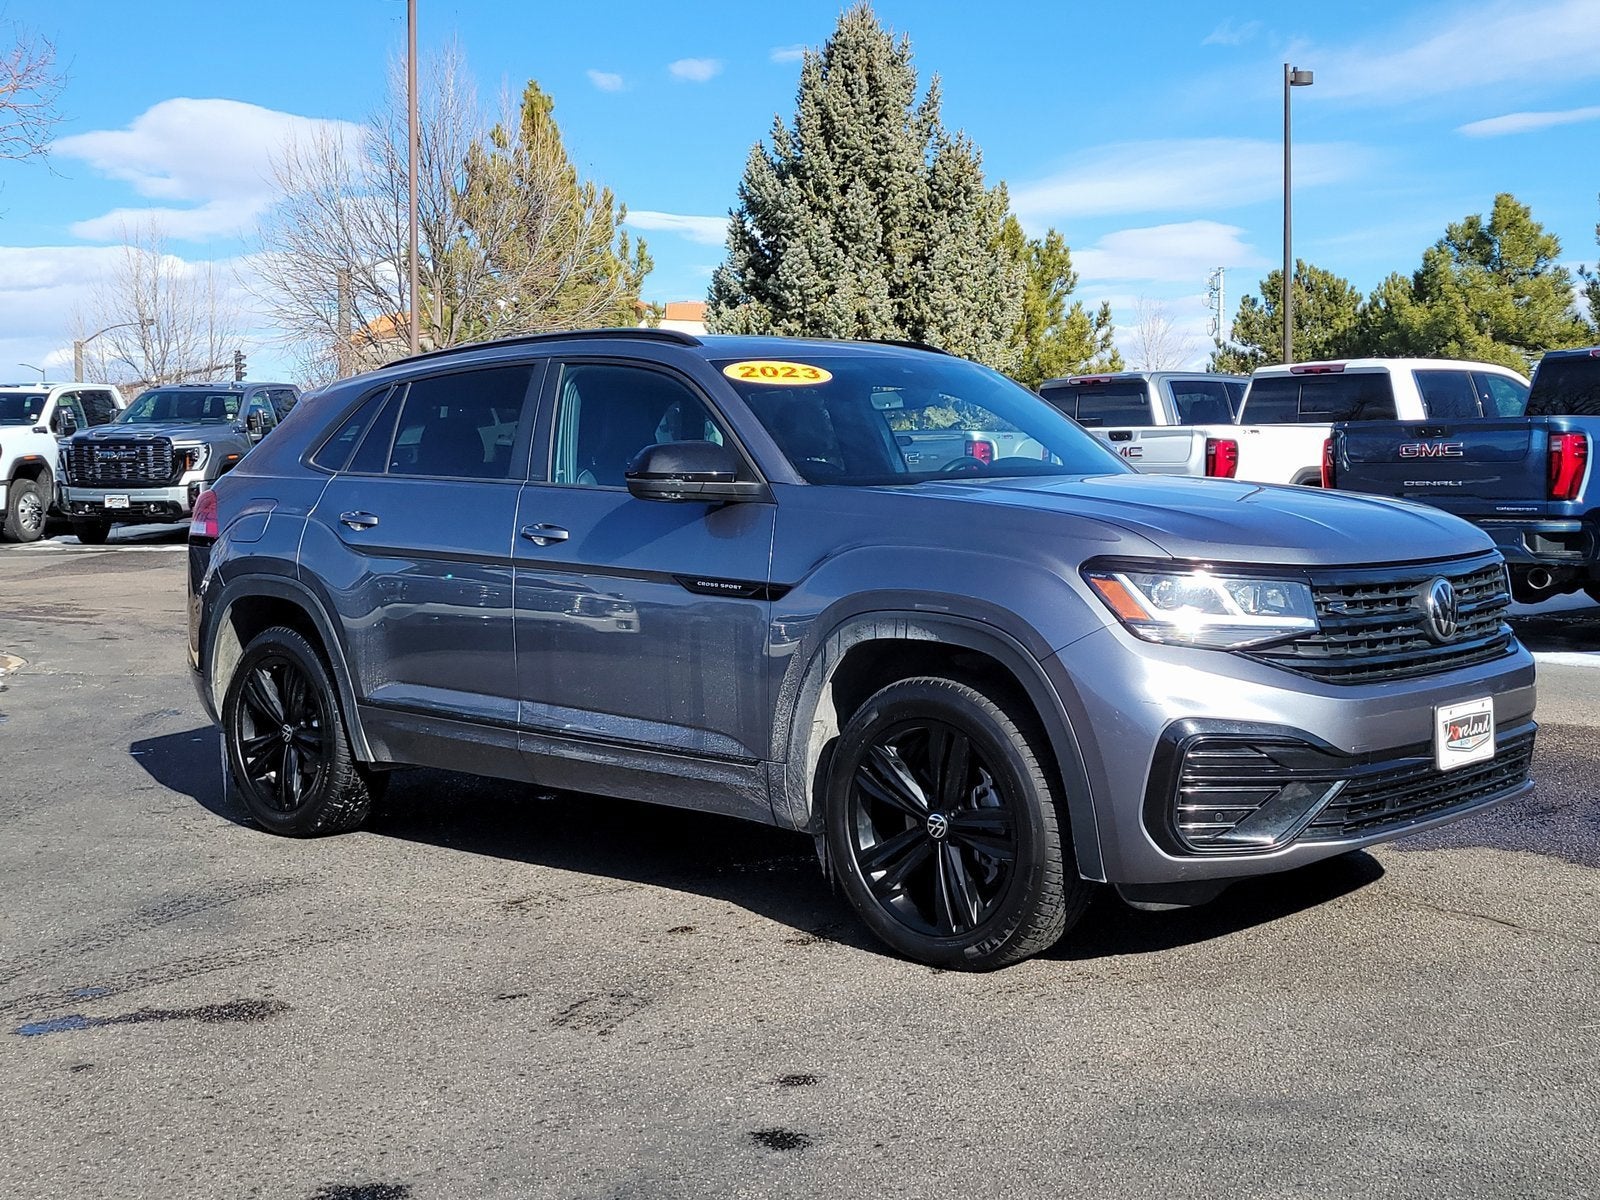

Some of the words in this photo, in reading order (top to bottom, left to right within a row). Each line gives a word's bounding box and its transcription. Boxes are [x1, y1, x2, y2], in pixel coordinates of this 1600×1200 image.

[738, 366, 820, 379] 2023
[95, 450, 138, 460] GMC
[1399, 442, 1463, 457] GMC
